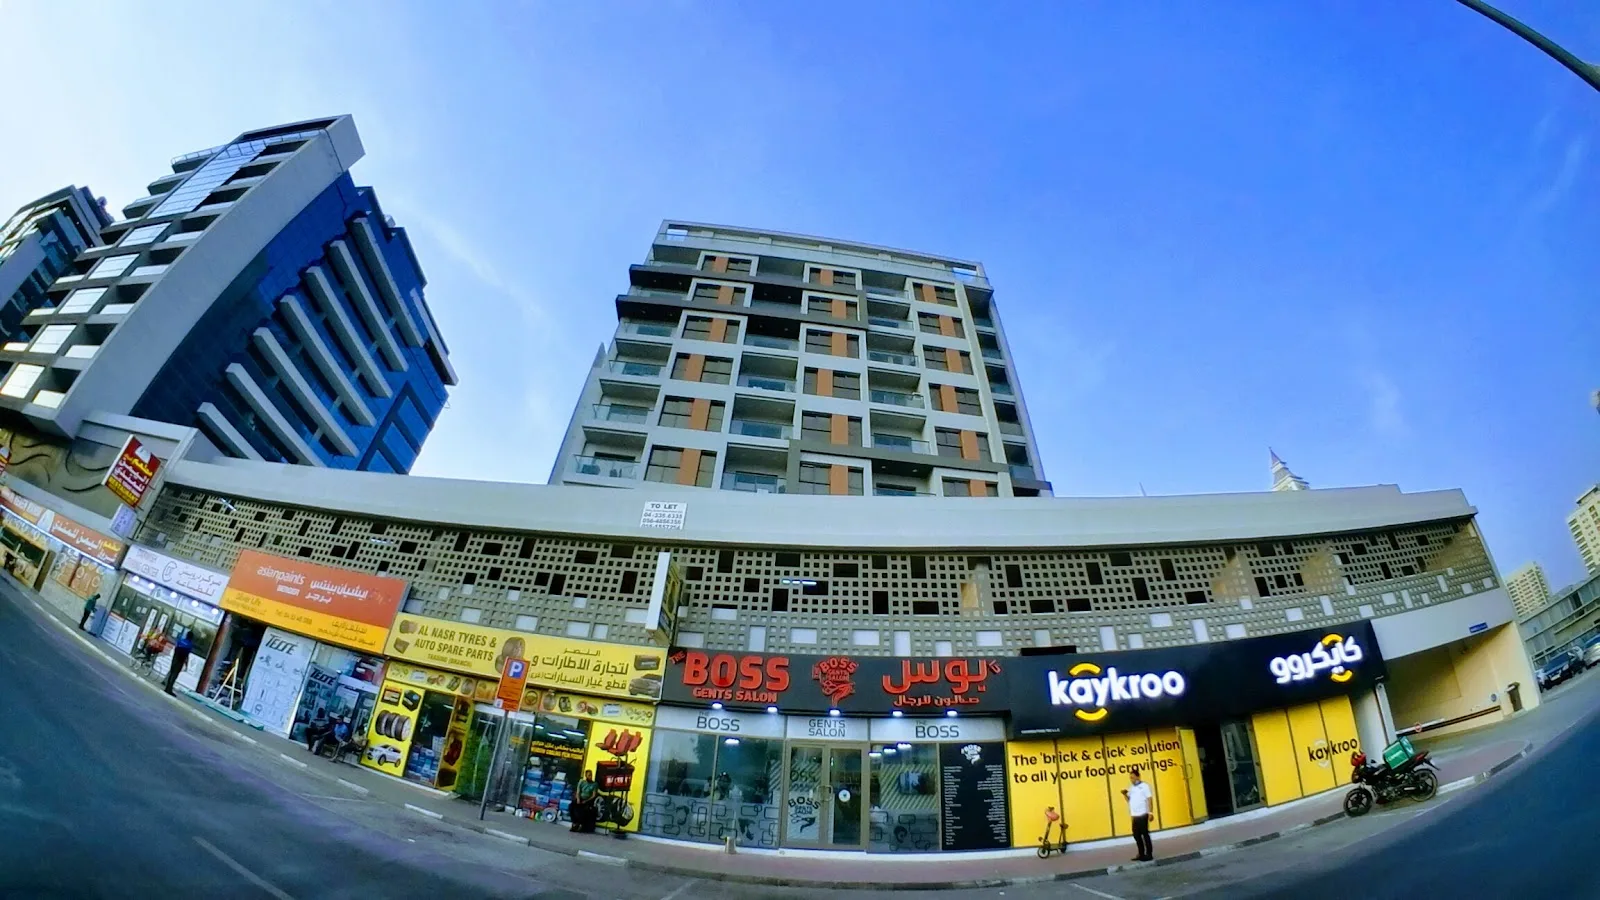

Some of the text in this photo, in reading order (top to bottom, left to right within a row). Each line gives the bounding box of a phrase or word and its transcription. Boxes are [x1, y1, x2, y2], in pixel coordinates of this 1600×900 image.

[257, 565, 305, 585] asianpaints
[418, 625, 498, 648] AL NASR TYRES &
[414, 638, 494, 662] AUTO SPARE PARTS
[509, 661, 523, 677] P
[531, 655, 629, 676] لتجارة الاطارات و
[669, 651, 686, 665] THE
[683, 651, 790, 691] BOSS
[819, 657, 858, 674] BOSS
[585, 677, 603, 688] غيار
[605, 679, 627, 691] قطع
[882, 659, 988, 695] بوس
[693, 688, 777, 702] GENTS SALON
[1048, 667, 1186, 707] kaykroo
[893, 694, 980, 707] صالون للرجال
[696, 716, 740, 732] BOSS
[808, 718, 845, 729] GENTS
[915, 725, 959, 738] BOSS
[808, 728, 845, 737] SALON
[1012, 739, 1181, 767] The 'brick & click' solution
[1307, 738, 1358, 762] kaykroo
[1014, 773, 1029, 784] to
[1031, 770, 1048, 783] all
[1051, 769, 1083, 784] your
[1086, 764, 1117, 778] food
[788, 796, 821, 810] BOSS
